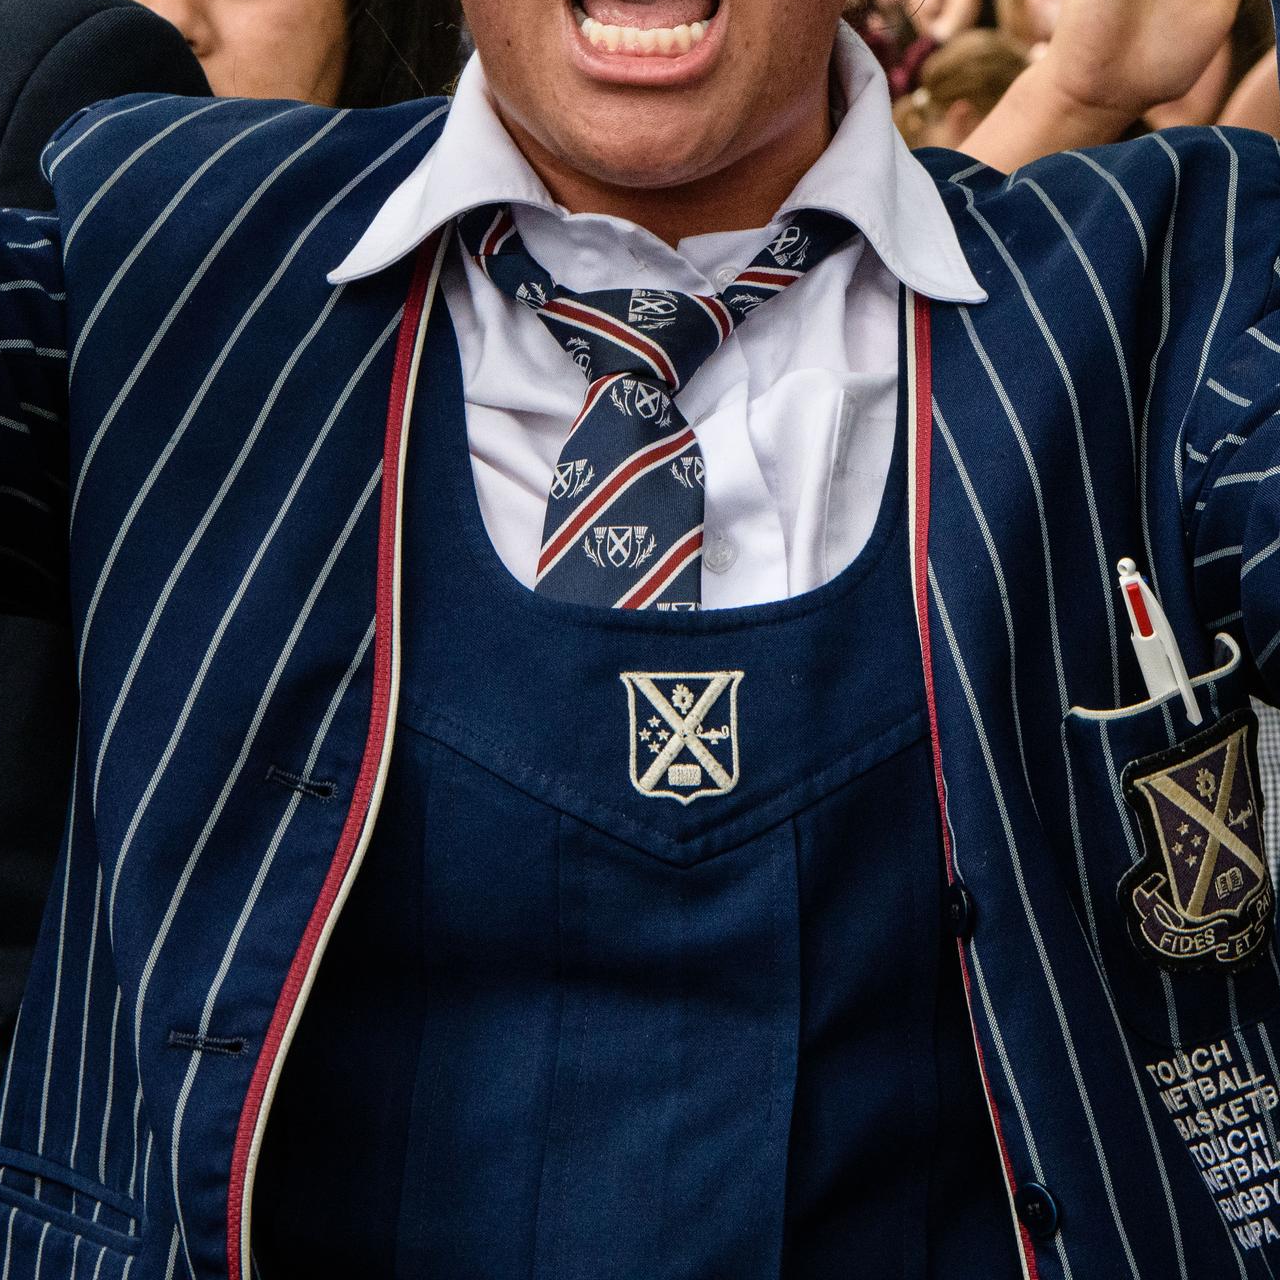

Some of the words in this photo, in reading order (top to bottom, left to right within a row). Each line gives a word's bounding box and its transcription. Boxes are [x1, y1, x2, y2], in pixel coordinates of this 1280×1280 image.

[1160, 928, 1216, 953] FIDES
[1236, 933, 1251, 955] ET
[1145, 1039, 1233, 1087] TOUCH
[1159, 1062, 1266, 1114] NETBALL
[1189, 1122, 1268, 1168] TOUCH
